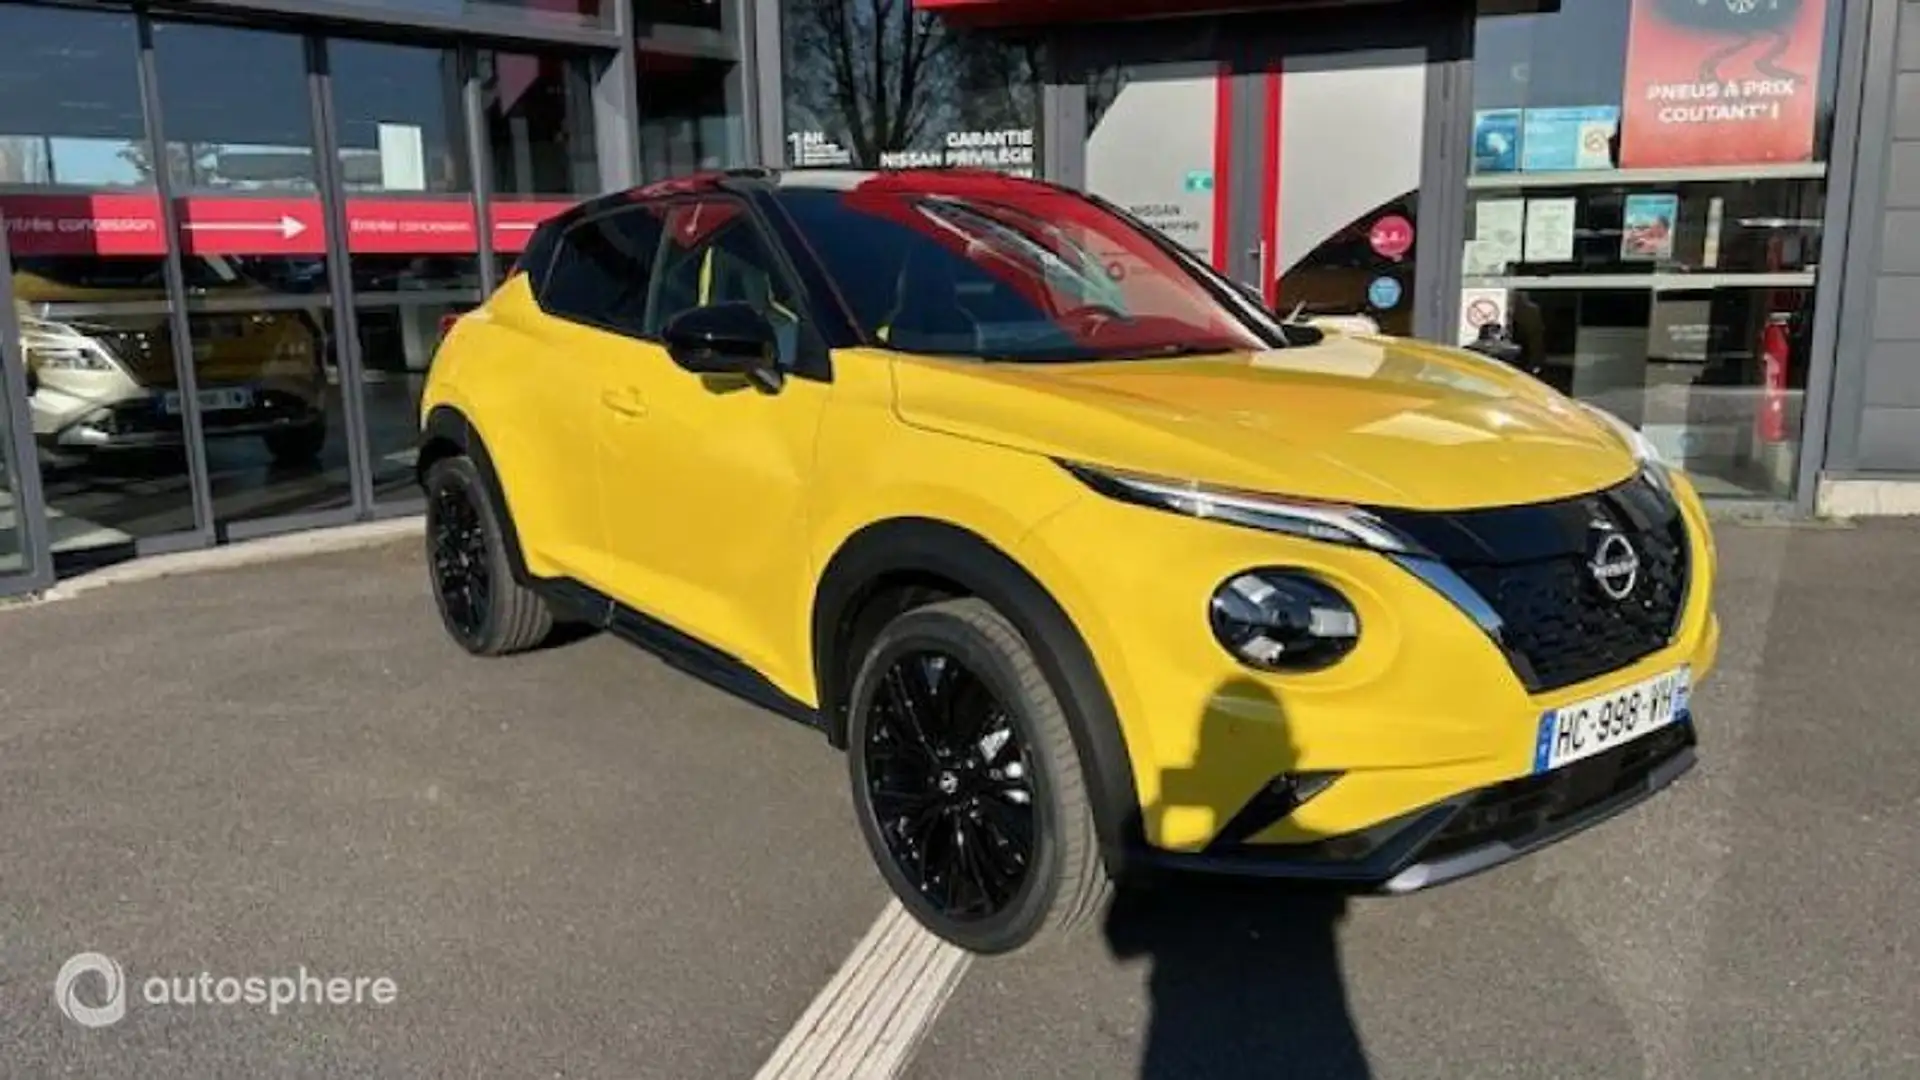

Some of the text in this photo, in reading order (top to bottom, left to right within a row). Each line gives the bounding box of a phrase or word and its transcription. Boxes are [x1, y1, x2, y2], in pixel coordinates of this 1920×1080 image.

[1648, 83, 1719, 100] PNEUS
[1742, 78, 1795, 97] PRIX
[947, 130, 1033, 148] GARANTIE
[880, 151, 942, 168] NISSAN
[57, 218, 156, 233] concession
